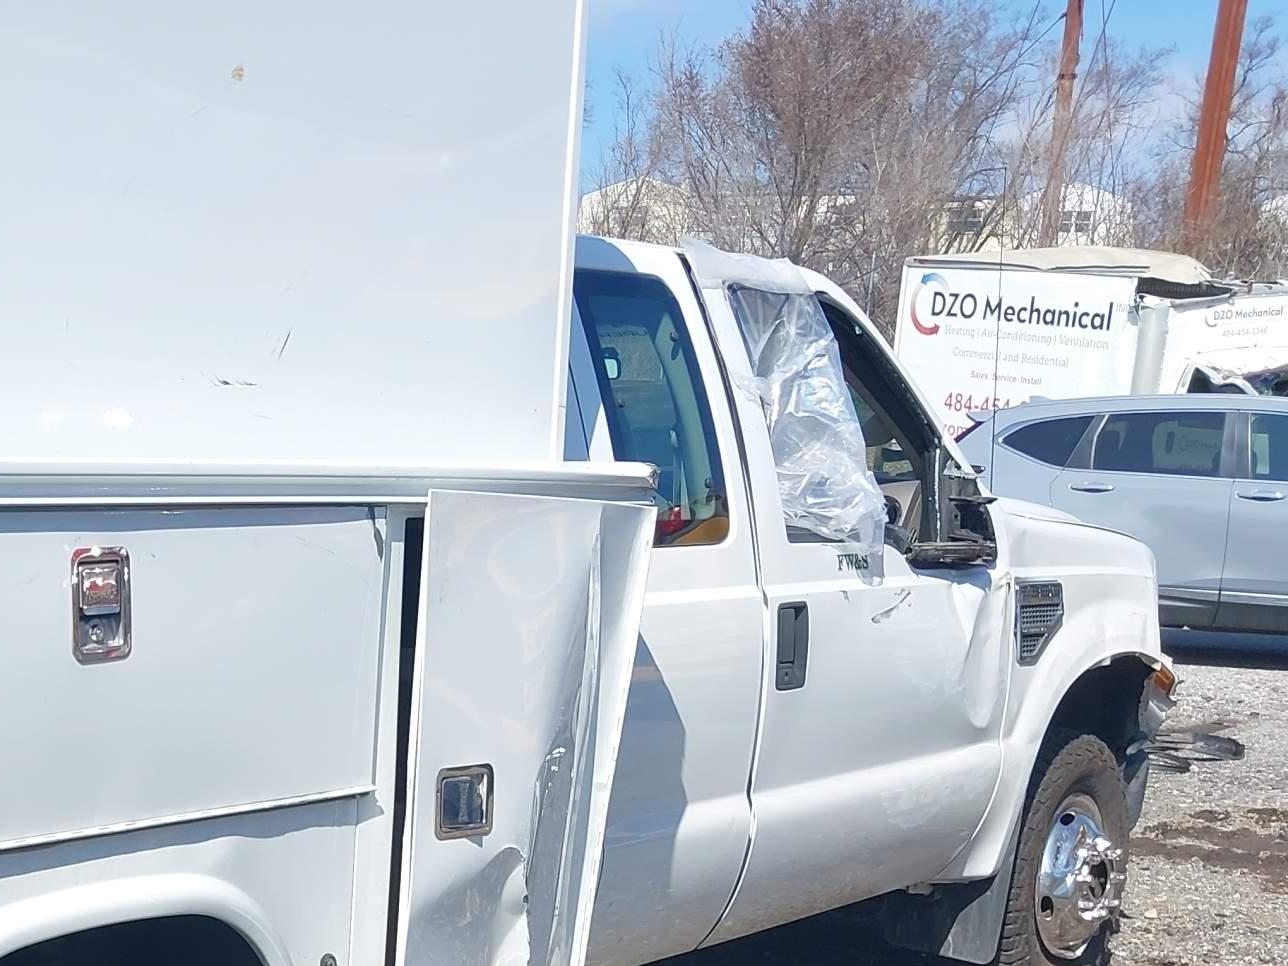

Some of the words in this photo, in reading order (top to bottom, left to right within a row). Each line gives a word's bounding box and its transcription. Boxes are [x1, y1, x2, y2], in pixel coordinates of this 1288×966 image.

[931, 291, 978, 319] DZO
[982, 294, 1114, 331] Mechanical
[1213, 309, 1233, 320] DZO
[1235, 305, 1284, 319] Mechanical
[944, 324, 975, 339] Heating
[1059, 334, 1109, 350] Ventilation
[1021, 353, 1069, 368] Residential
[970, 370, 988, 380] Sales
[1020, 376, 1042, 385] Install
[837, 553, 869, 571] FW&S
